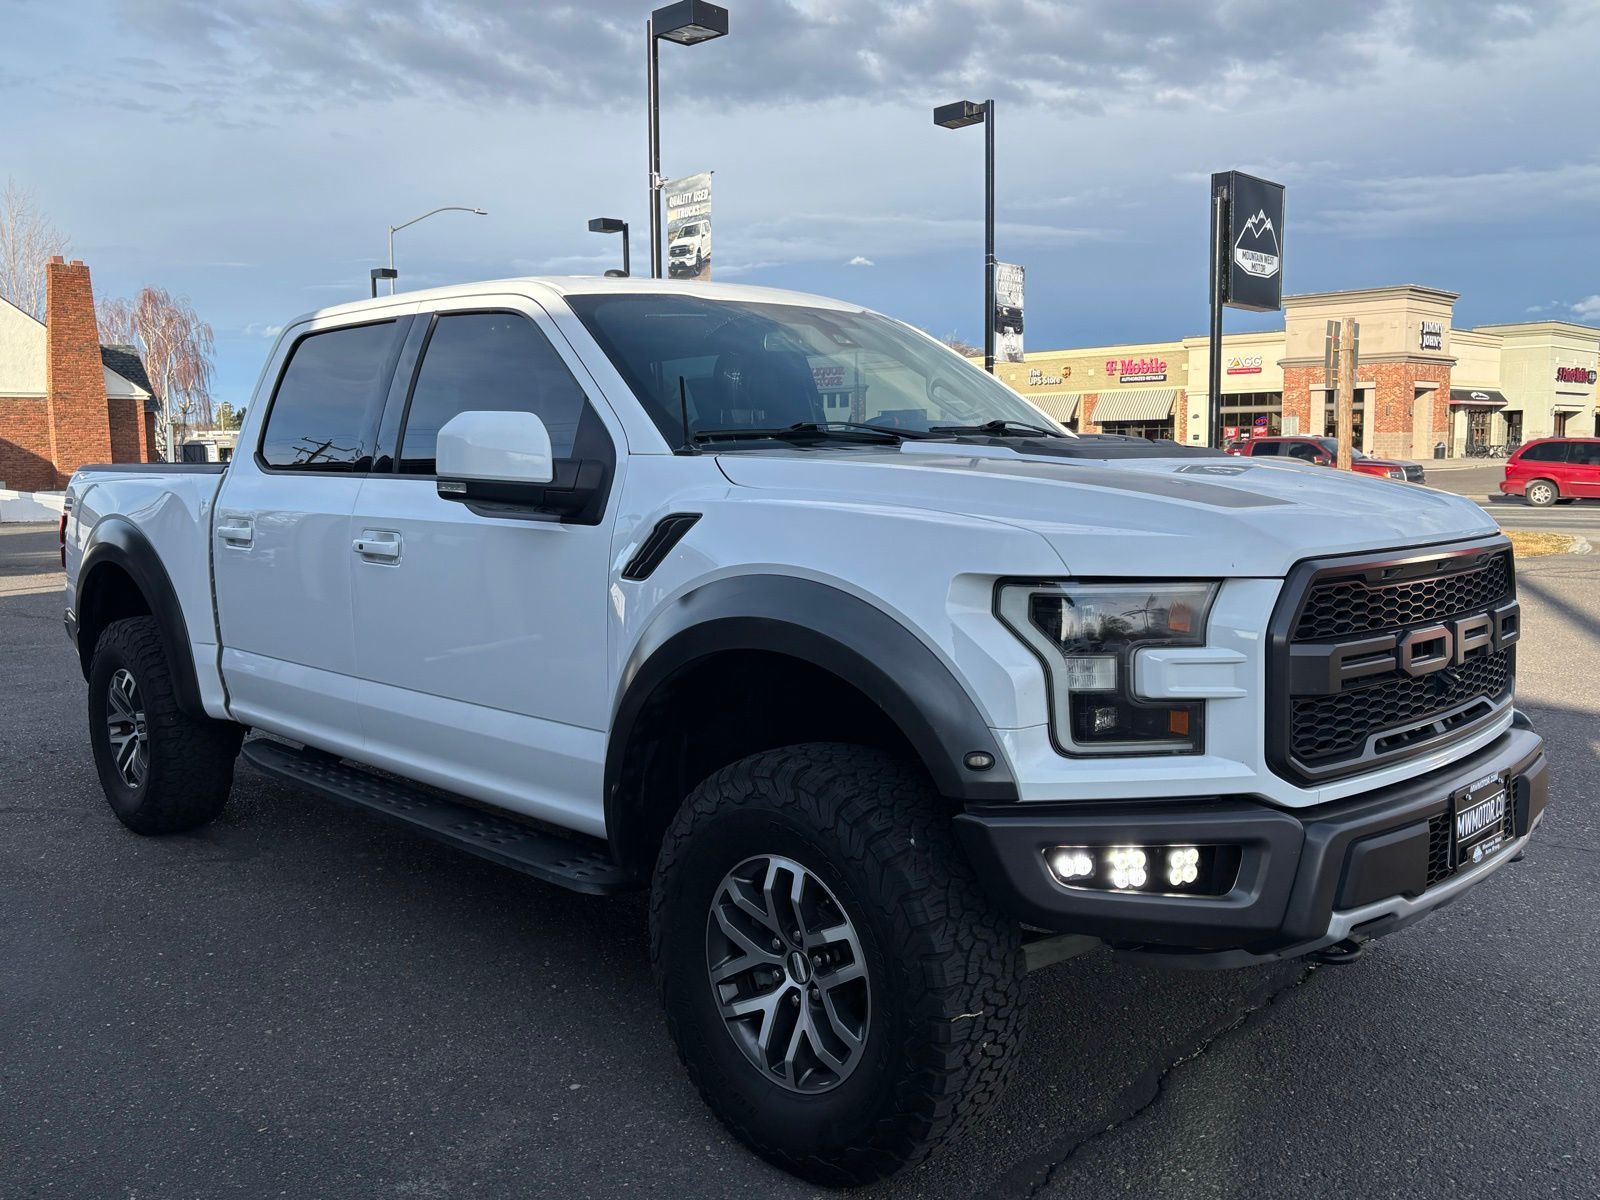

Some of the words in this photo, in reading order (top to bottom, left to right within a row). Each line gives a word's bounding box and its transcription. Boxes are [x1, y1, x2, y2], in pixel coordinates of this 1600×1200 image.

[669, 192, 692, 208] QUALITY
[694, 189, 709, 203] USED
[677, 205, 700, 219] TRUCKS
[1242, 250, 1263, 263] MOUNTAIN
[1264, 254, 1275, 265] WEST
[1251, 262, 1266, 273] MOTOR
[1423, 321, 1443, 334] JIMMY
[1422, 334, 1443, 348] JOHN'S
[1227, 357, 1263, 369] ZAGG
[1029, 368, 1042, 377] The
[1028, 377, 1043, 386] UPS
[1043, 376, 1062, 385] Store
[1329, 600, 1521, 695] FORD
